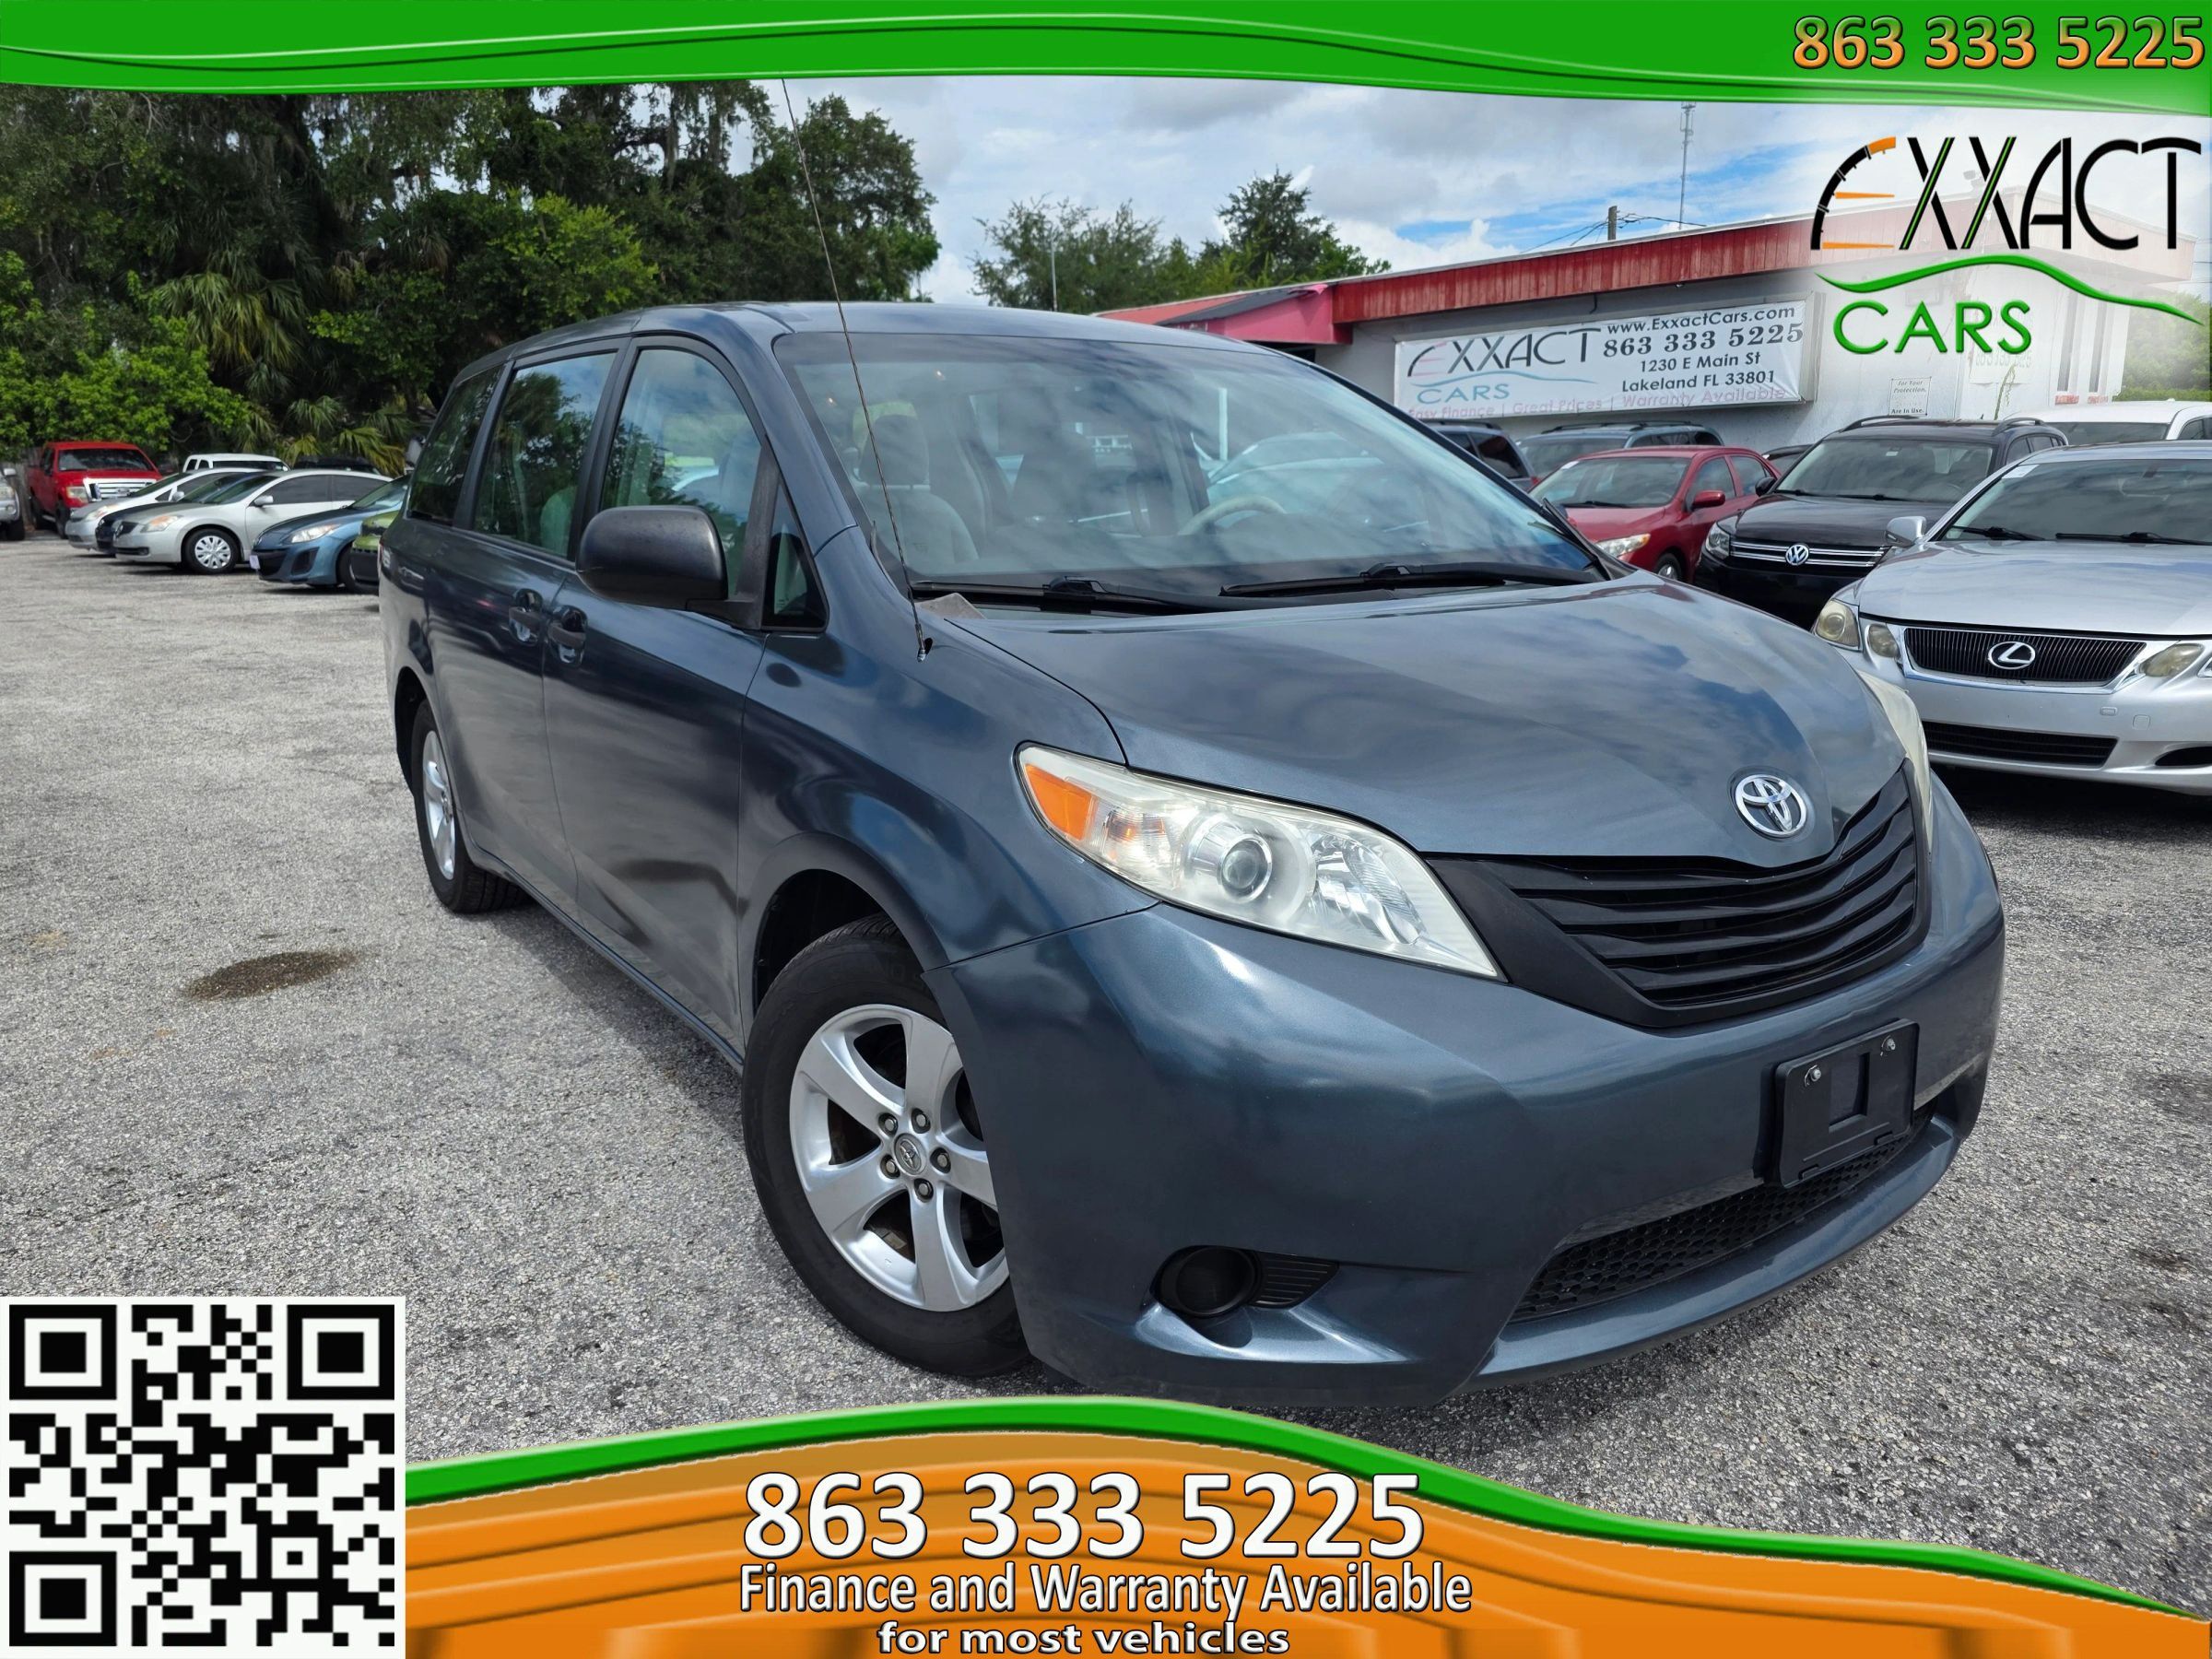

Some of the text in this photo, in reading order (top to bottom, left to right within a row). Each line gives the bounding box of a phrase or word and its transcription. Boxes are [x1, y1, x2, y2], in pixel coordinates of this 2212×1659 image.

[1607, 307, 1794, 335] www.ExxactCars.com
[1407, 328, 1601, 377] EXXACT
[1603, 323, 1804, 358] 863 333 5225
[1641, 351, 1760, 372] 1230 E Main St
[1417, 383, 1510, 405] CARS
[1622, 371, 1774, 393] Lakeland FL 33801
[1512, 402, 1551, 414] Great
[1623, 392, 1695, 407] Warranty
[1700, 386, 1785, 404] Available
